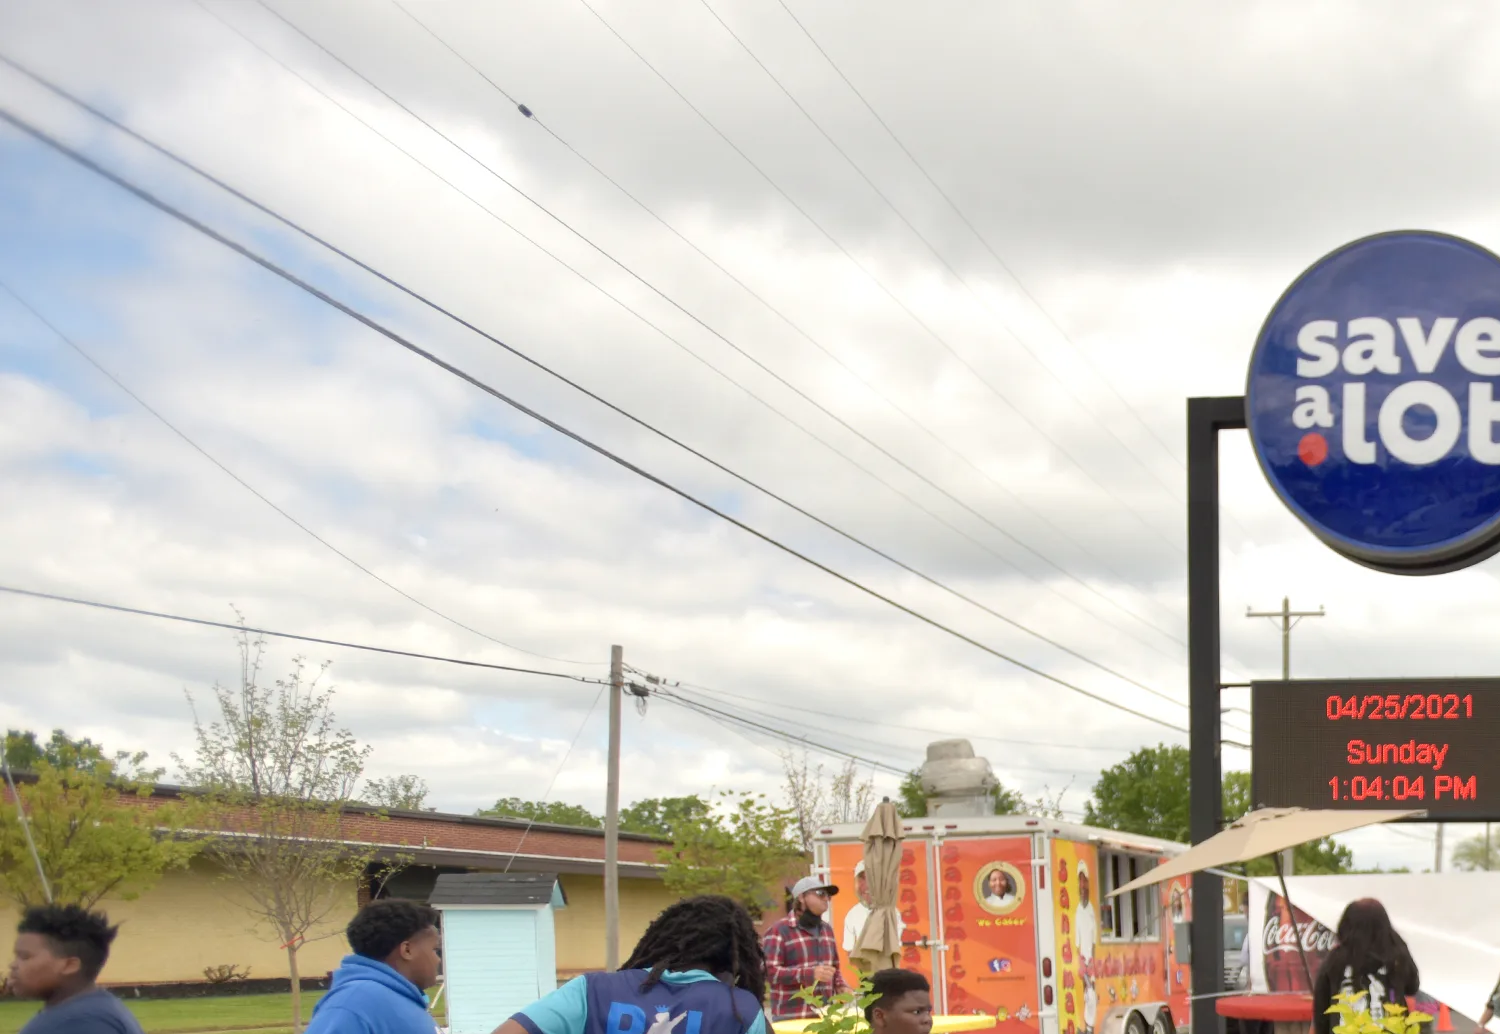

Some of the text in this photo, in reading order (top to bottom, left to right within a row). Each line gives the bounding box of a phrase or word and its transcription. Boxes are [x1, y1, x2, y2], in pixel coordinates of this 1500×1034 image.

[1292, 385, 1334, 429] a
[1326, 693, 1474, 722] 04/25/2021
[1346, 739, 1449, 771] Sunday
[1328, 775, 1477, 801] 1:04:04 PM
